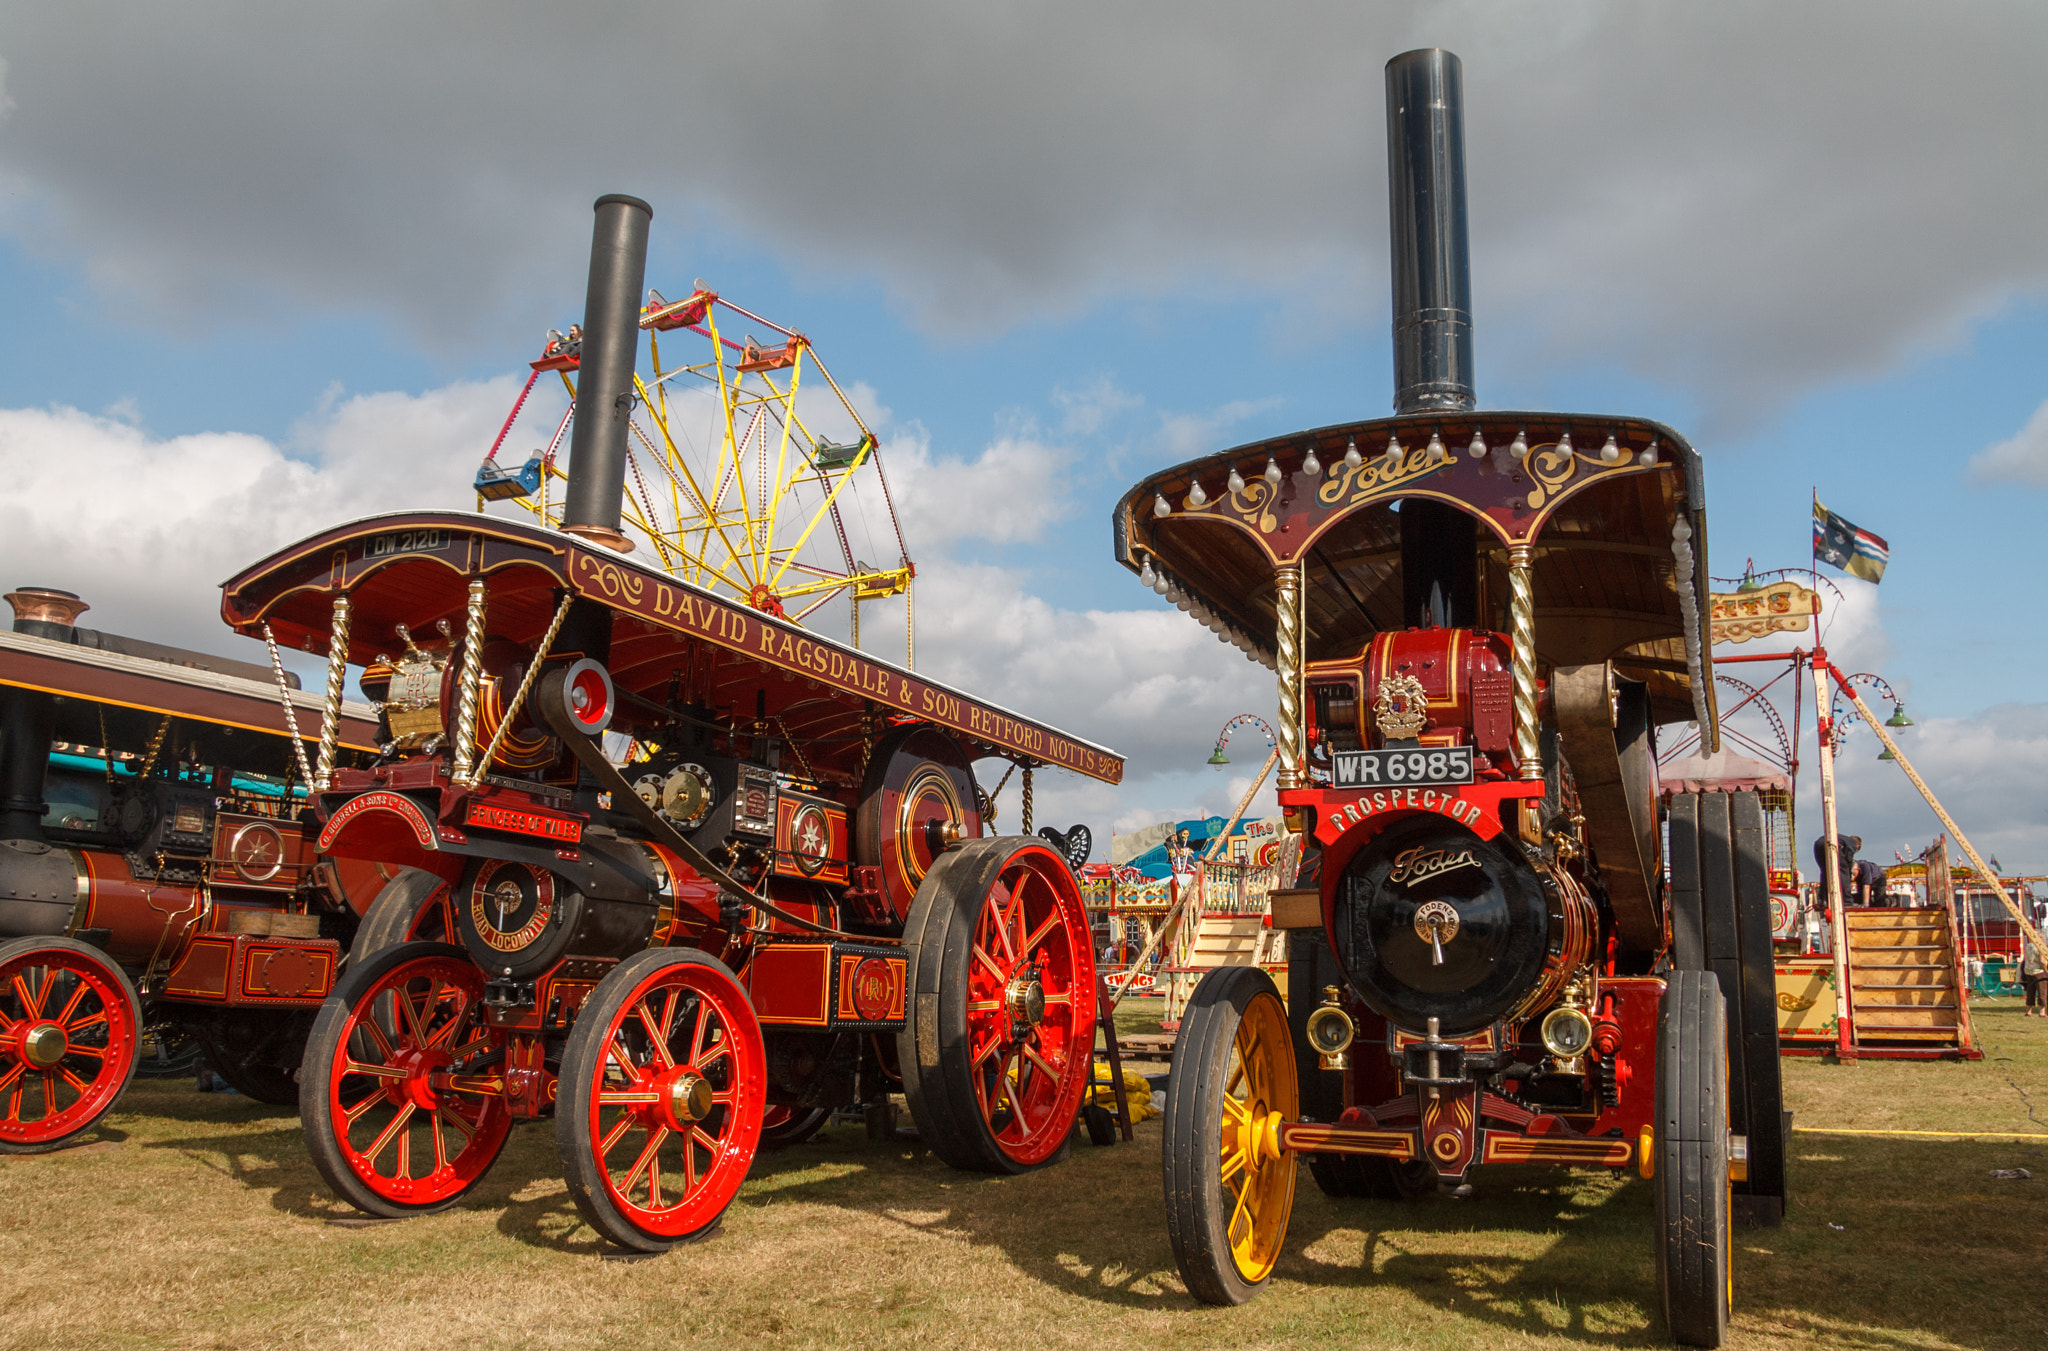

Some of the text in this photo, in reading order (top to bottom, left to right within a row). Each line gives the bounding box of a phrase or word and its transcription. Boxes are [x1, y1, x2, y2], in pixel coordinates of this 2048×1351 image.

[1319, 442, 1459, 503] Foden
[374, 530, 439, 555] DW 2120
[653, 583, 1095, 770] DAVID RAGSDALE & SON RETFORD NOTTS
[1336, 751, 1470, 783] WR 6985
[359, 798, 366, 808] &
[366, 795, 387, 806] SONS
[397, 800, 430, 841] ENGINEERS
[470, 805, 577, 839] PRINCESS OF WALES
[1329, 788, 1481, 833] PROSPECTOR
[1246, 822, 1274, 838] The
[1389, 846, 1482, 887] Foden
[473, 902, 552, 949] ROAD LOCOMOTIVE
[1420, 902, 1454, 916] FODENS
[1107, 973, 1154, 988] SWNGS
